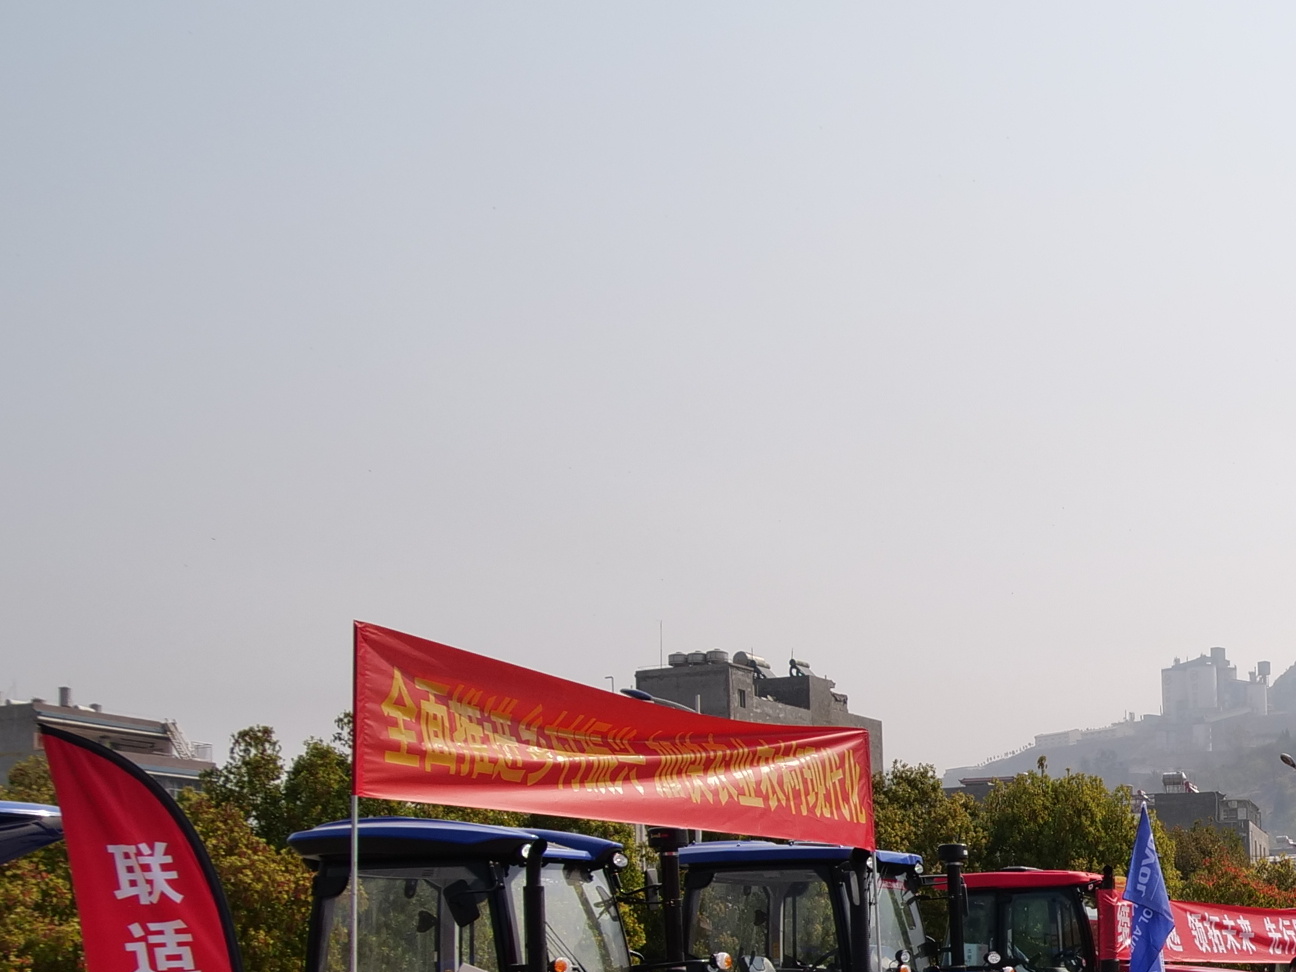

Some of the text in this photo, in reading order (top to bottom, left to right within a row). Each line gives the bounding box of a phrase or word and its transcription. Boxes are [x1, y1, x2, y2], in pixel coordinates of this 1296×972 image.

[382, 666, 867, 824] 全面推进乡村振兴 加快农业农村现代化
[1187, 911, 1257, 955] 领拓未来
